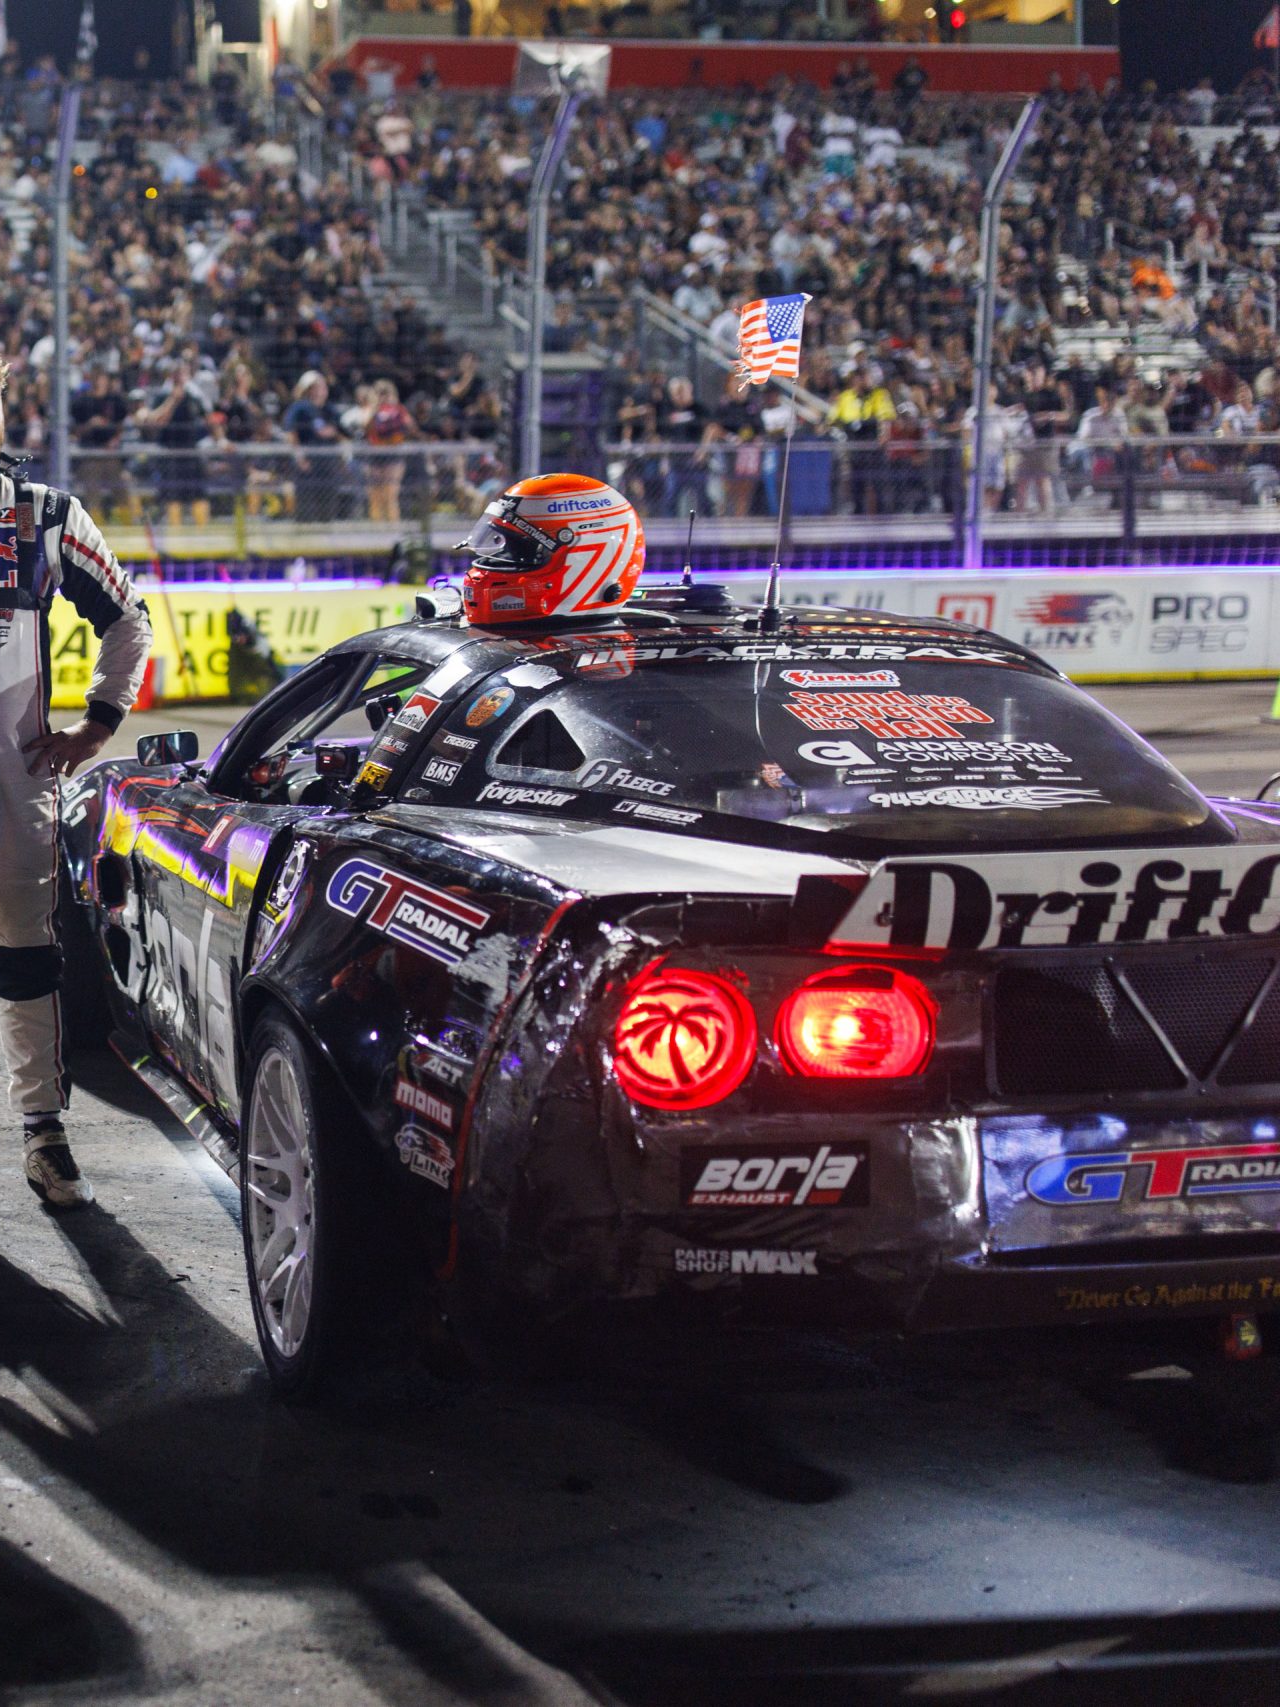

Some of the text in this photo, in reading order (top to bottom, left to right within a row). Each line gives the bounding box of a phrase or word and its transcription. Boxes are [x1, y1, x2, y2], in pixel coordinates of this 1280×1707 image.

[547, 498, 612, 514] driftcave
[1150, 595, 1249, 621] PRO
[1149, 625, 1249, 653] SPEC
[789, 691, 913, 705] Sound
[783, 703, 935, 720] Heaven
[804, 718, 964, 738] Like Hell
[876, 741, 1061, 752] ANDERSON
[883, 751, 1073, 763] COMPOSITES
[425, 762, 457, 783] BMS
[606, 769, 676, 797] FLEECE
[475, 781, 578, 807] forgestar
[395, 904, 470, 951] RADIAL
[424, 1056, 463, 1084] ACT
[1191, 1160, 1280, 1180] RADI
[692, 1193, 791, 1204] EXHAUST
[675, 1249, 730, 1260] PARTS
[731, 1251, 818, 1275] MAX
[676, 1261, 729, 1272] SHOP
